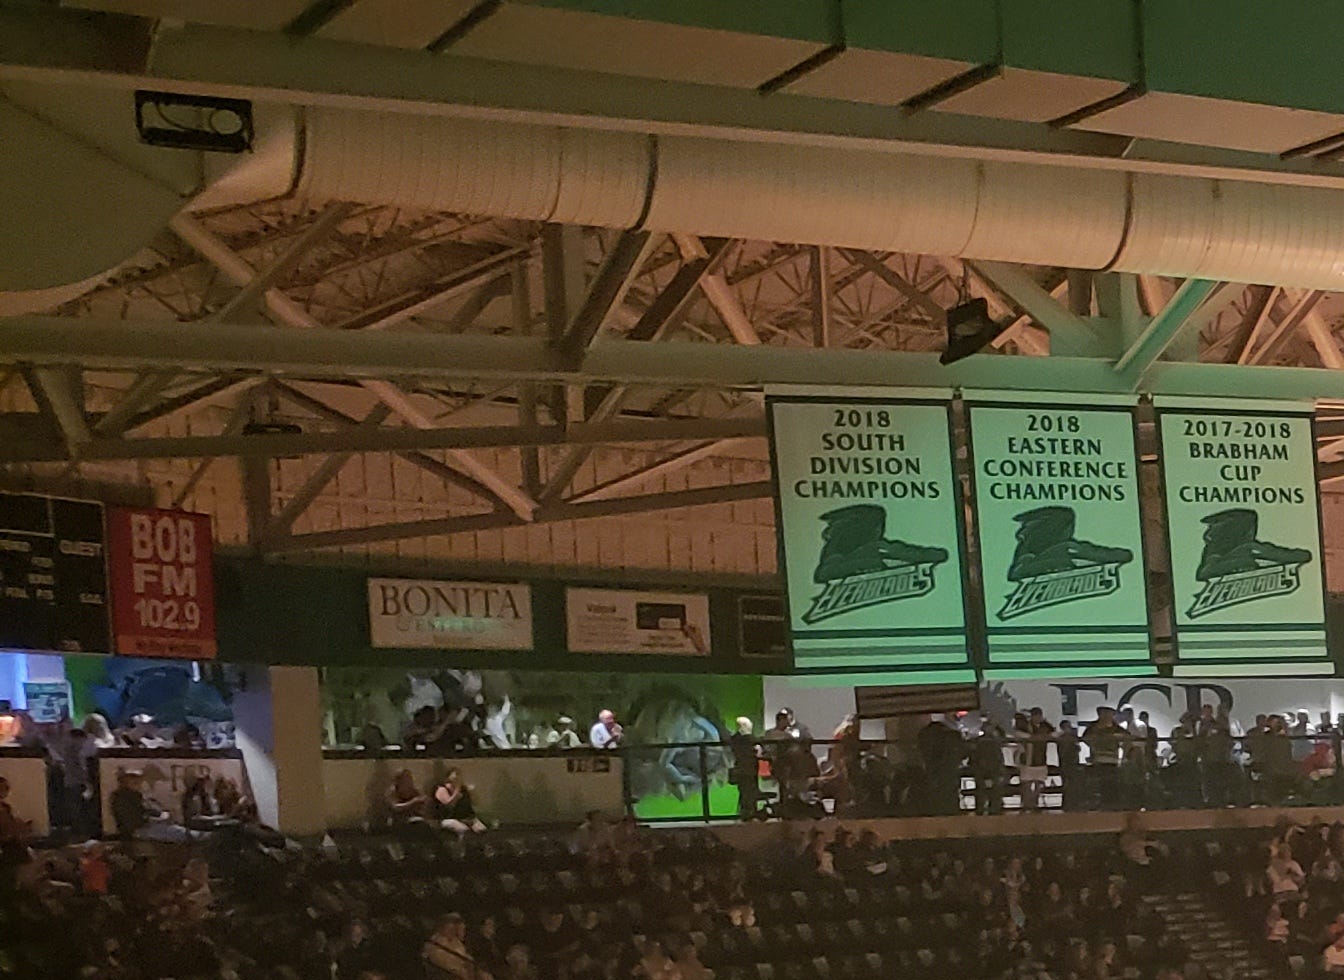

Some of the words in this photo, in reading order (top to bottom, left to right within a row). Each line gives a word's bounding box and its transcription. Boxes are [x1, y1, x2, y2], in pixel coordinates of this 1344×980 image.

[834, 409, 891, 428] 2018
[1027, 414, 1081, 433] 2018
[1183, 420, 1291, 438] 2017-2018
[821, 433, 905, 451] SOUTH
[1008, 437, 1102, 455] EASTERN
[1189, 442, 1289, 461] BRABHAM
[810, 457, 921, 475] DIVISION
[983, 460, 1129, 479] CONFERENCE
[1220, 464, 1262, 482] CUP
[794, 480, 941, 499] CHAMPIONS
[990, 483, 1126, 501] CHAMPIONS
[1179, 486, 1305, 504] CHAMPIONS
[131, 513, 197, 564] BOB
[132, 563, 198, 597] FM
[379, 583, 522, 620] BONITA
[134, 598, 200, 631] 102.9
